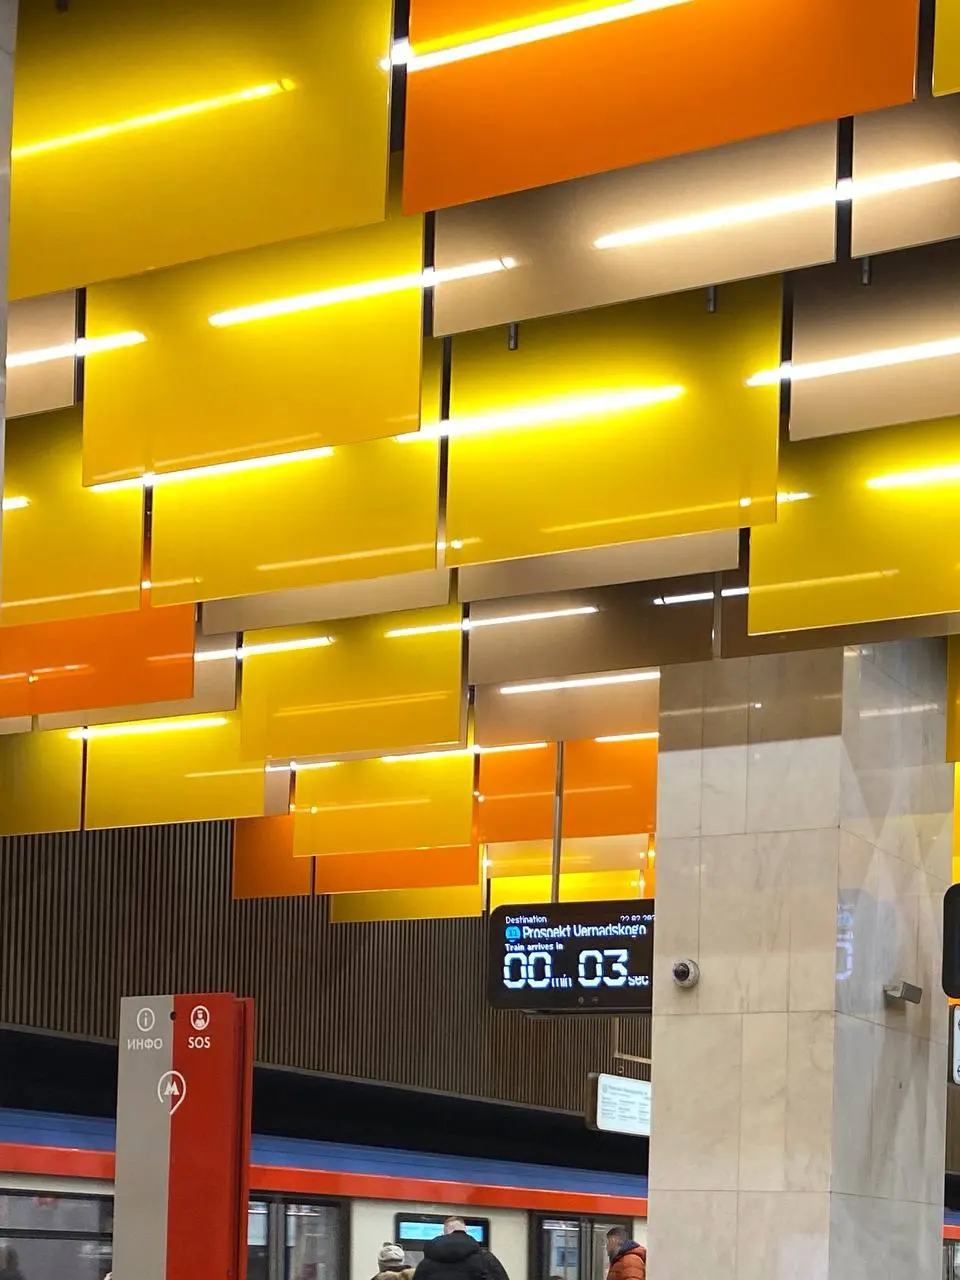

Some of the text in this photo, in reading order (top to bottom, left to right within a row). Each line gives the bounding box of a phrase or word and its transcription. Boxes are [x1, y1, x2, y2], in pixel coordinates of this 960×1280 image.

[505, 915, 548, 924] Destination
[505, 941, 564, 952] Train arrives in
[503, 949, 650, 989] 00 min 03 sec
[127, 1038, 163, 1050] ИНФО
[188, 1036, 211, 1049] SOS
